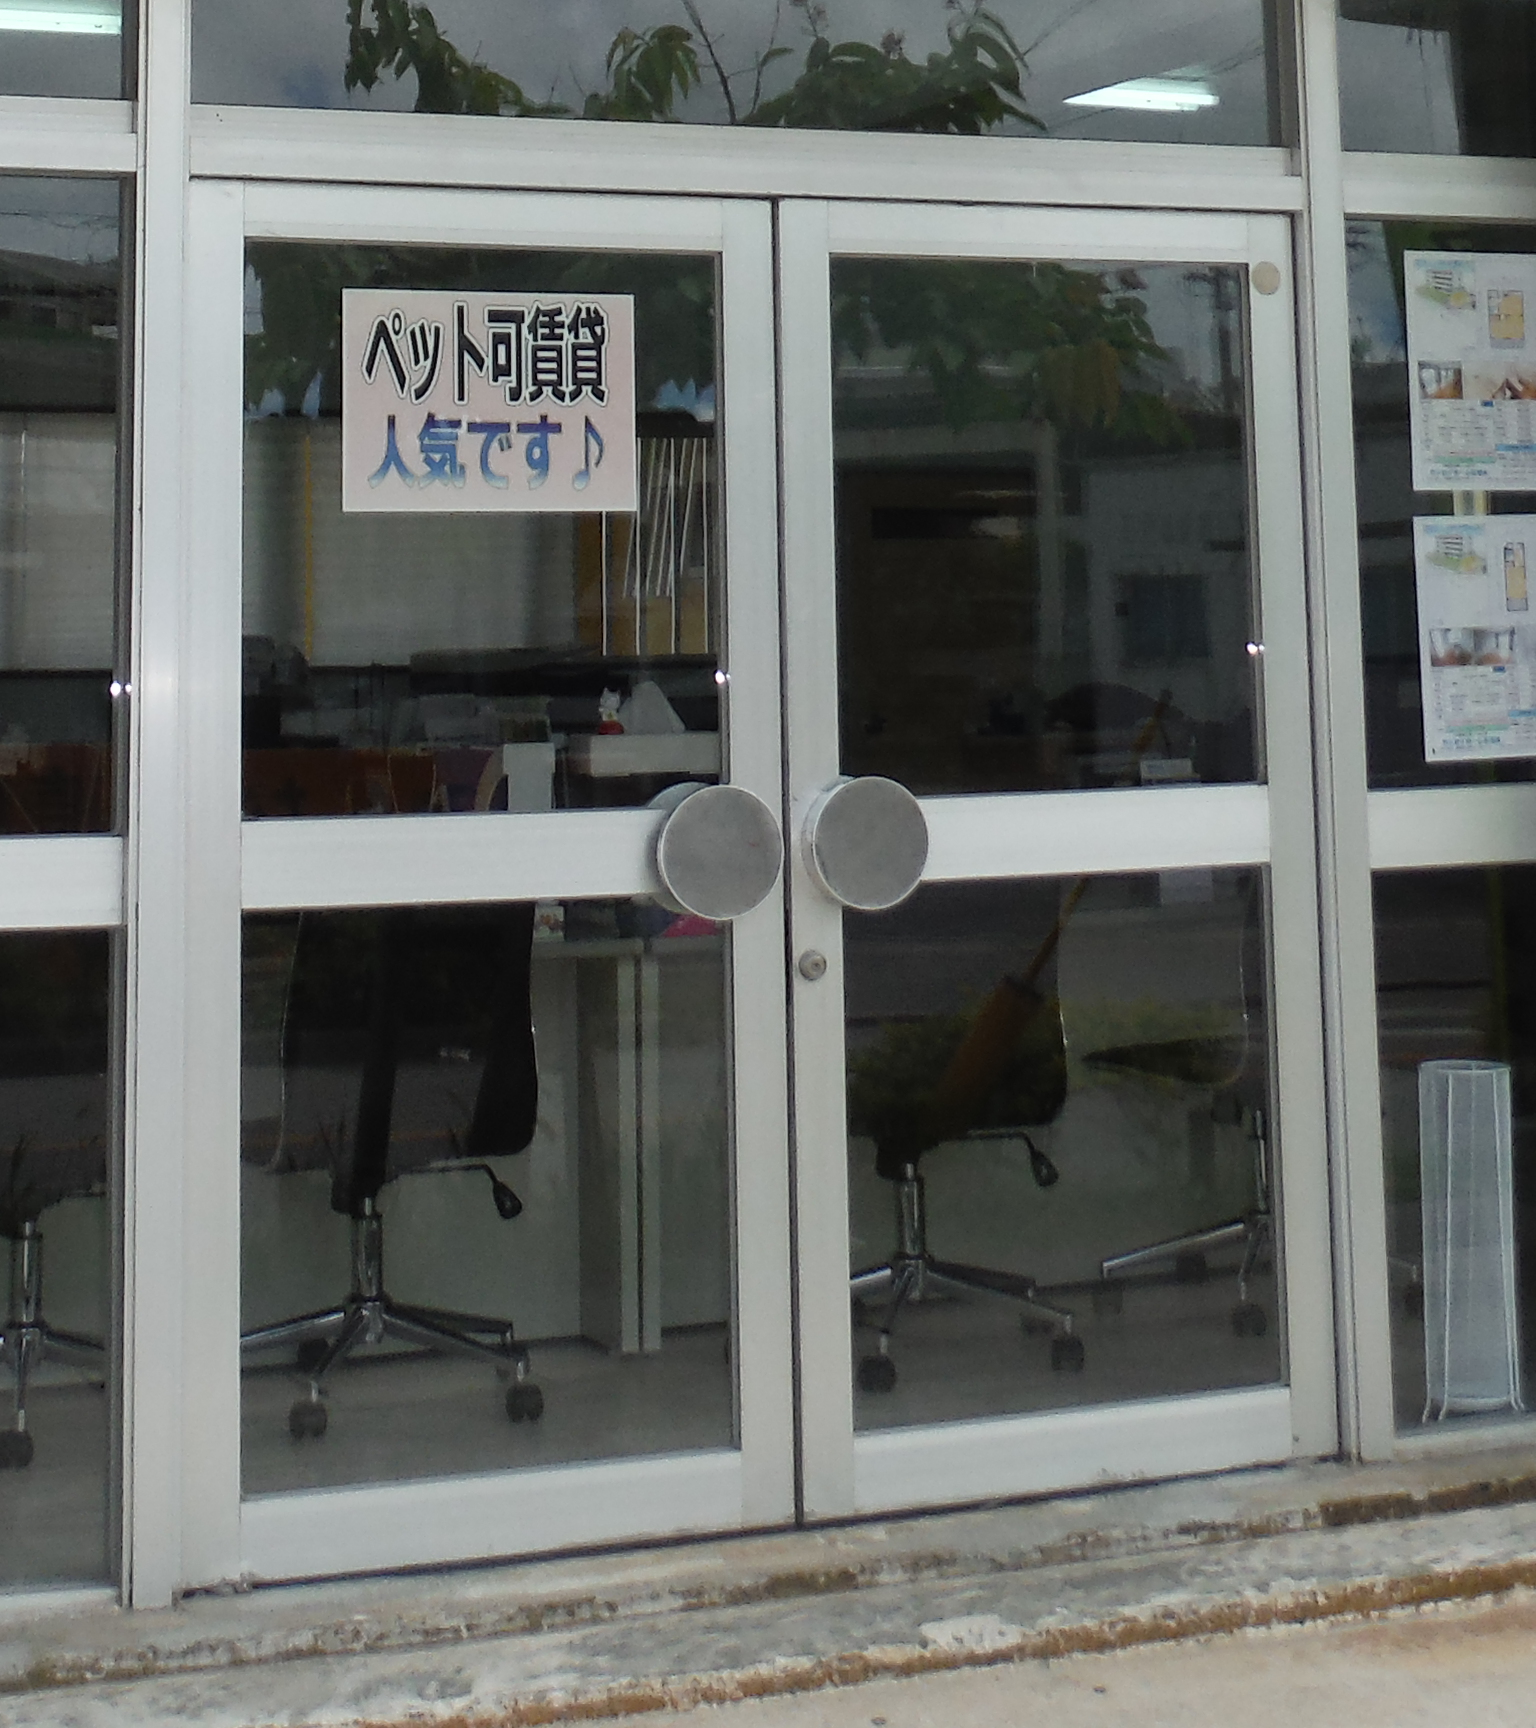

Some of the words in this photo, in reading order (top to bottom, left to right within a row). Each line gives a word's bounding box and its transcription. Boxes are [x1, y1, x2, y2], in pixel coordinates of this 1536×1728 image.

[362, 300, 610, 406] ペット可賃貸
